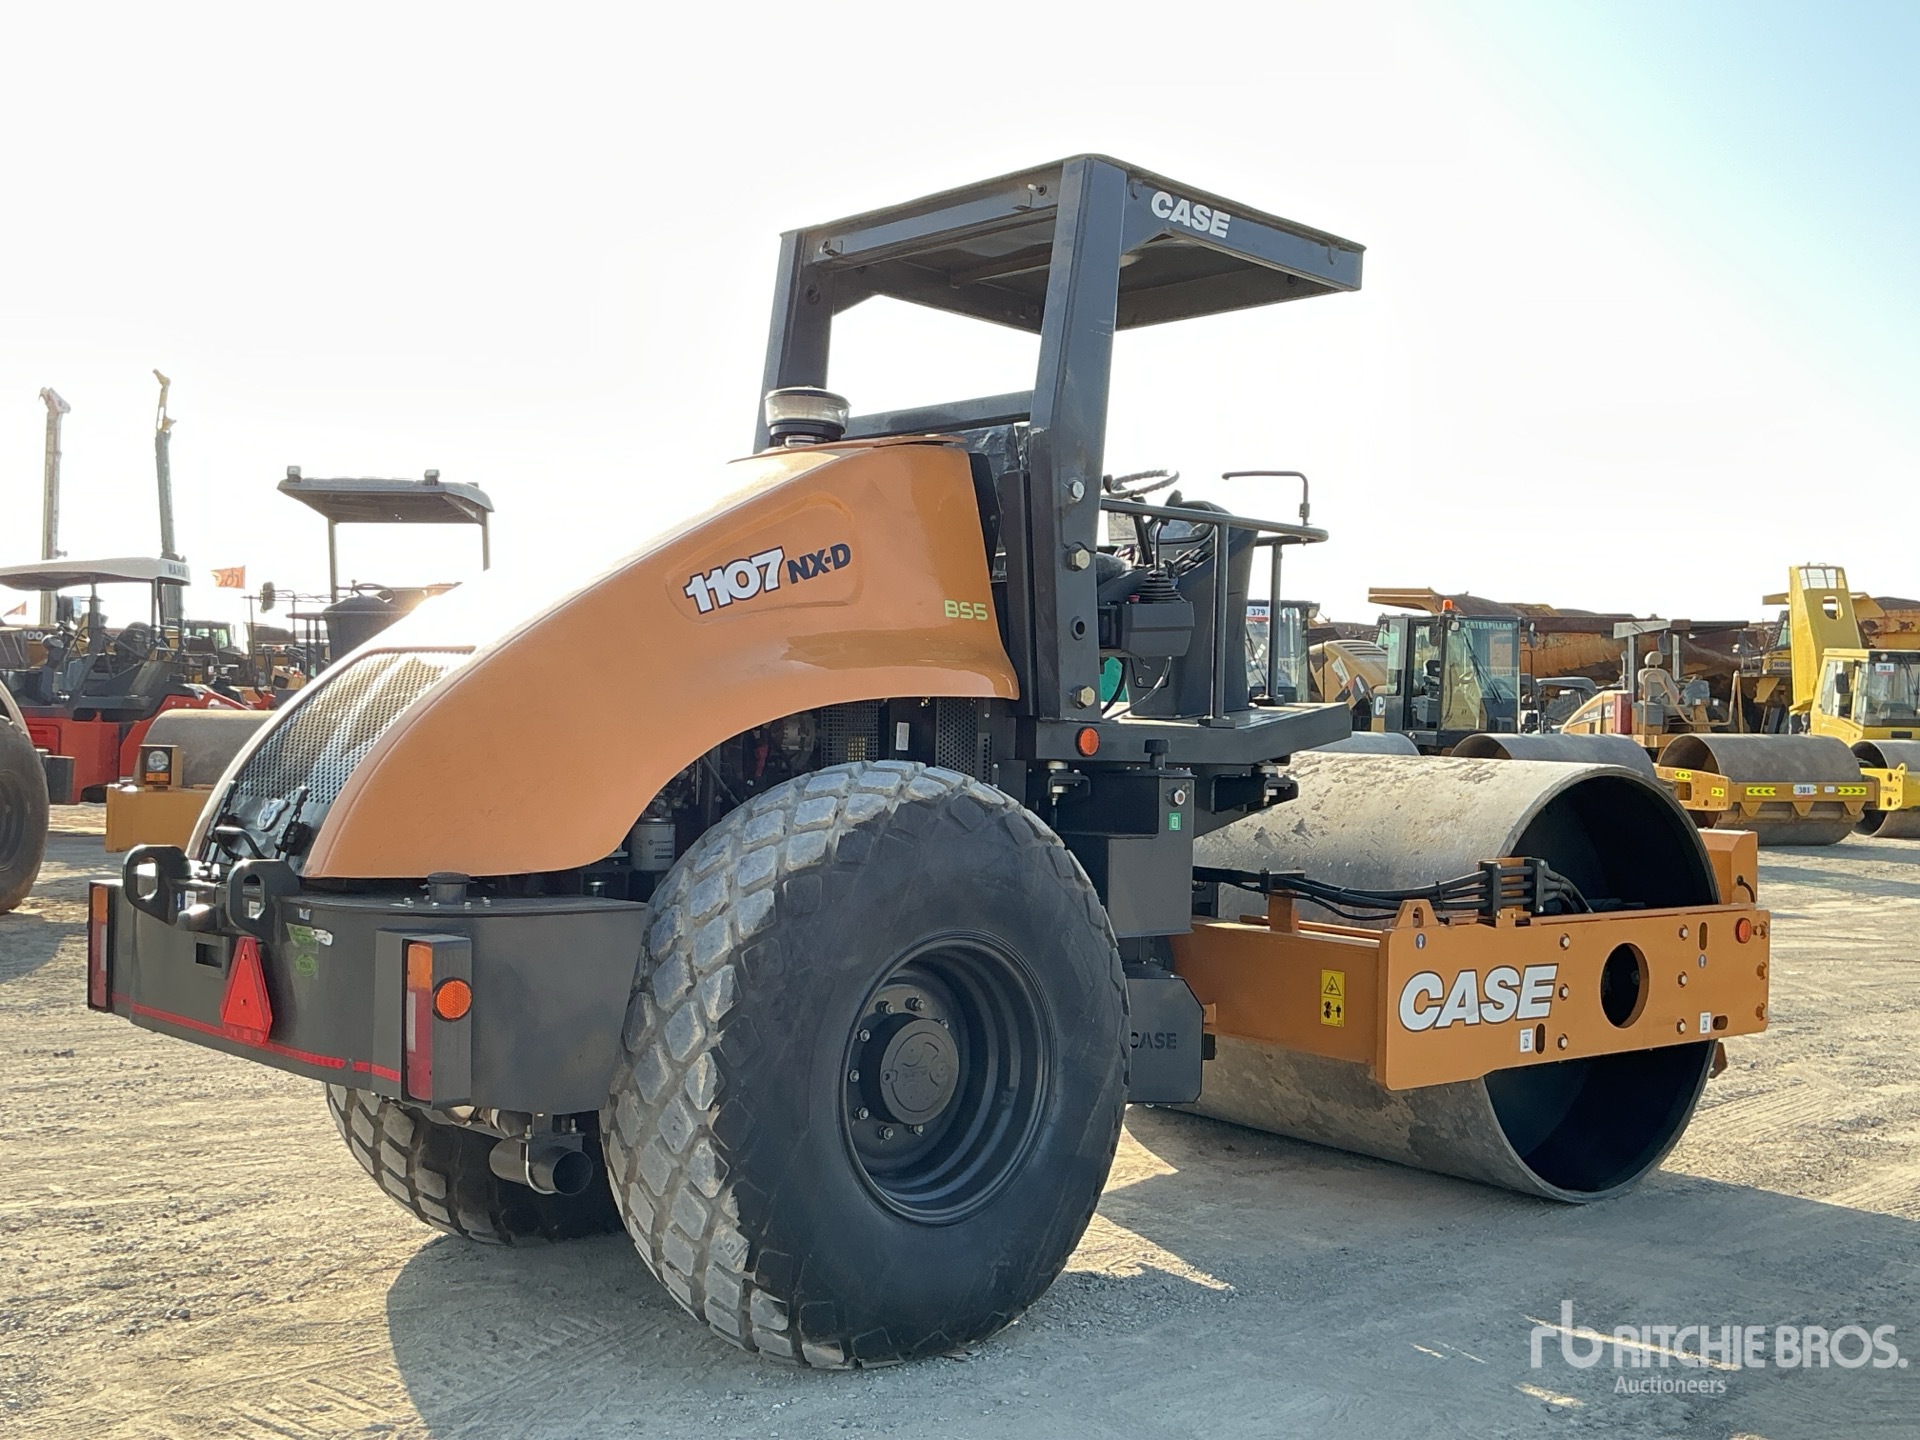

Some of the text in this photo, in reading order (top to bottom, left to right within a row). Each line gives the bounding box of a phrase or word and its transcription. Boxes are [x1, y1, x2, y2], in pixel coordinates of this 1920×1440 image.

[1151, 191, 1231, 238] CASE
[682, 543, 851, 614] 1107 NX-D
[944, 600, 988, 621] BS5
[1251, 608, 1266, 616] 379
[1464, 621, 1513, 630] CATERPILLAR
[1798, 786, 1811, 794] 381
[1398, 963, 1559, 1033] CASE
[1129, 1031, 1177, 1049] CASE
